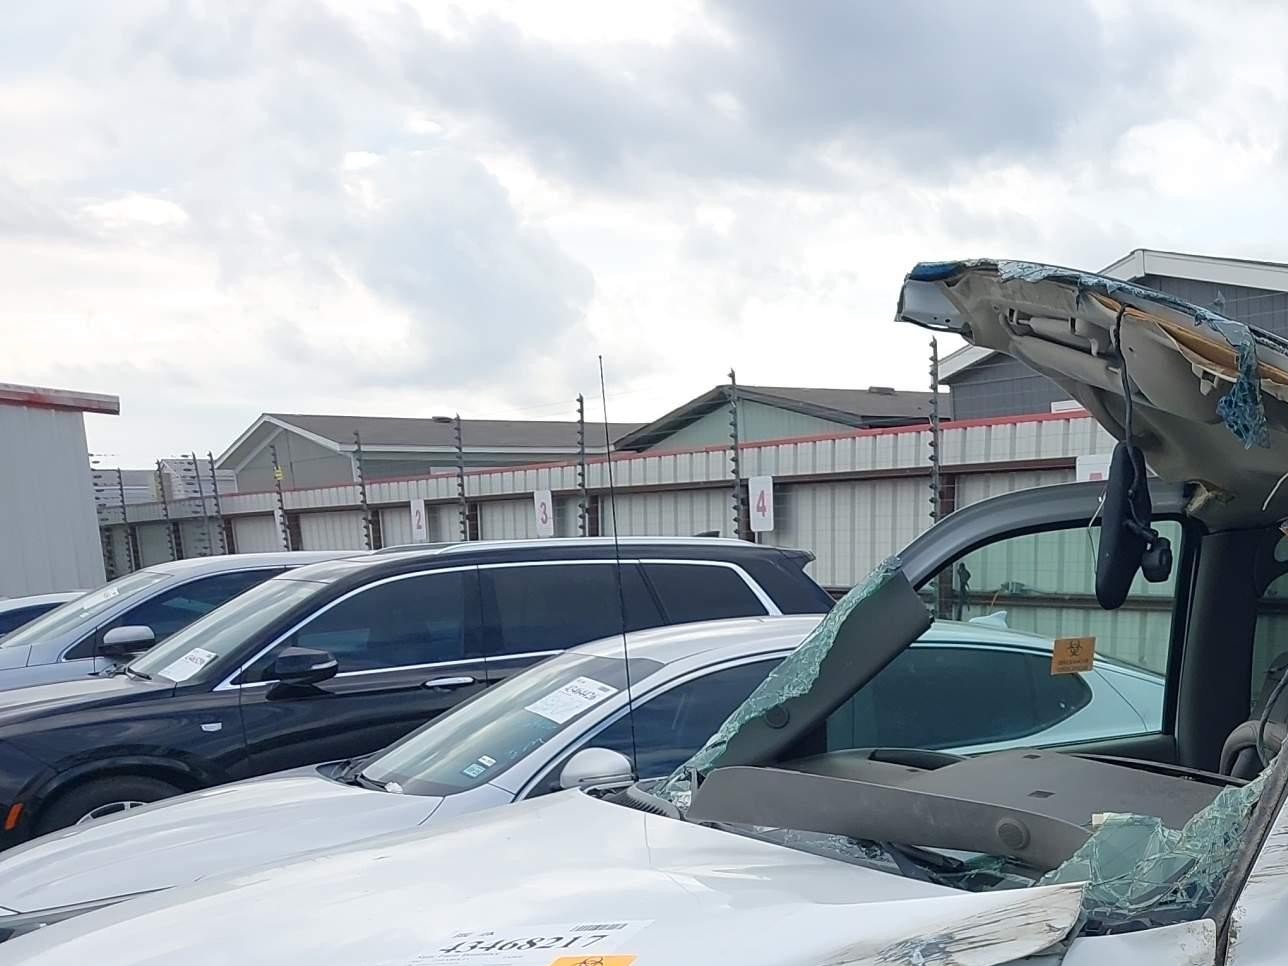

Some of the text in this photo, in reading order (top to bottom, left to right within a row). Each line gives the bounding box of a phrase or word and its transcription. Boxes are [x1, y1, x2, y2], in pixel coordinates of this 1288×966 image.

[540, 501, 548, 525] 3
[756, 489, 767, 518] 4
[415, 509, 423, 530] 2
[439, 934, 609, 954] 43468217
